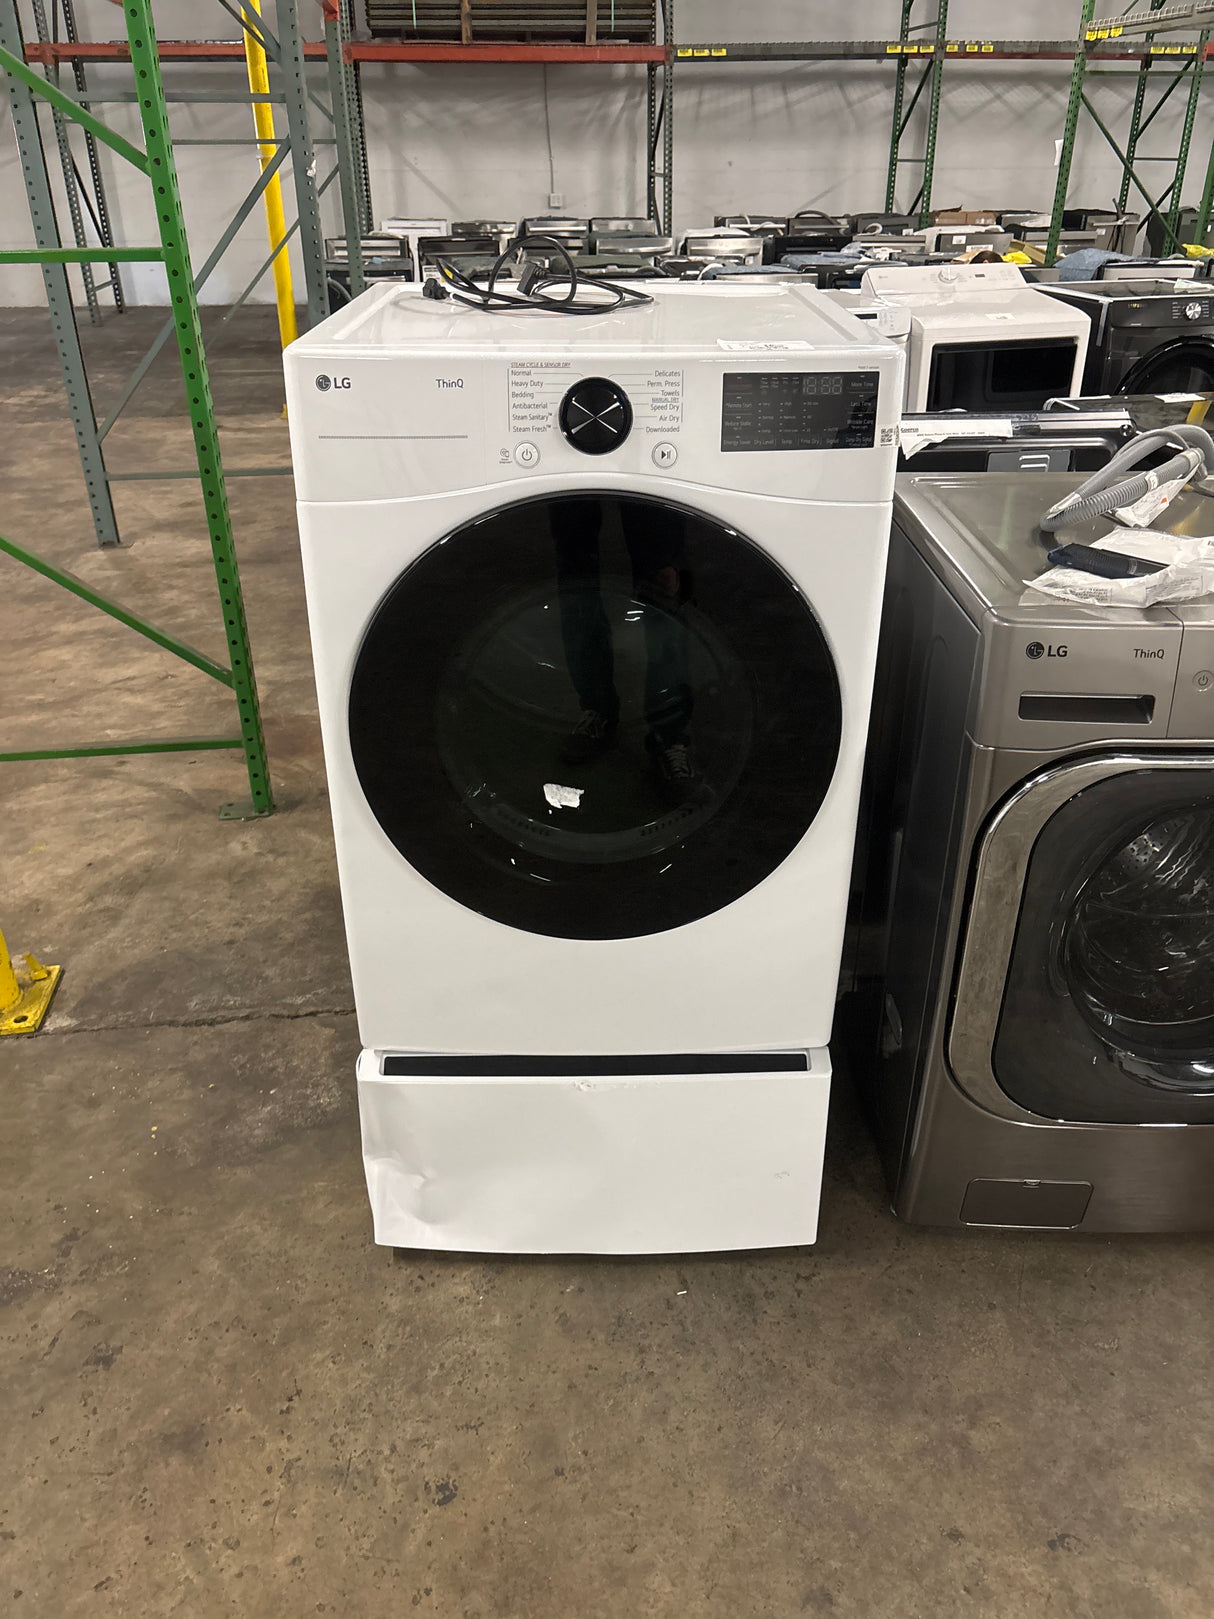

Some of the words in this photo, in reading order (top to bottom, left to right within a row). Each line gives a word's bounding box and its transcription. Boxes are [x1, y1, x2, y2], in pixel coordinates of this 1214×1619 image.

[511, 369, 532, 377] Normal
[334, 377, 351, 389] LG
[435, 378, 464, 389] ThinQ
[511, 380, 529, 388] Heavy
[529, 380, 544, 388] Duty
[511, 391, 535, 399] Bedding
[512, 402, 548, 410] Antibacterial
[650, 404, 668, 412] Speed
[669, 415, 680, 423] Dry
[1047, 645, 1068, 658] LG
[1133, 649, 1165, 659] ThinQ
